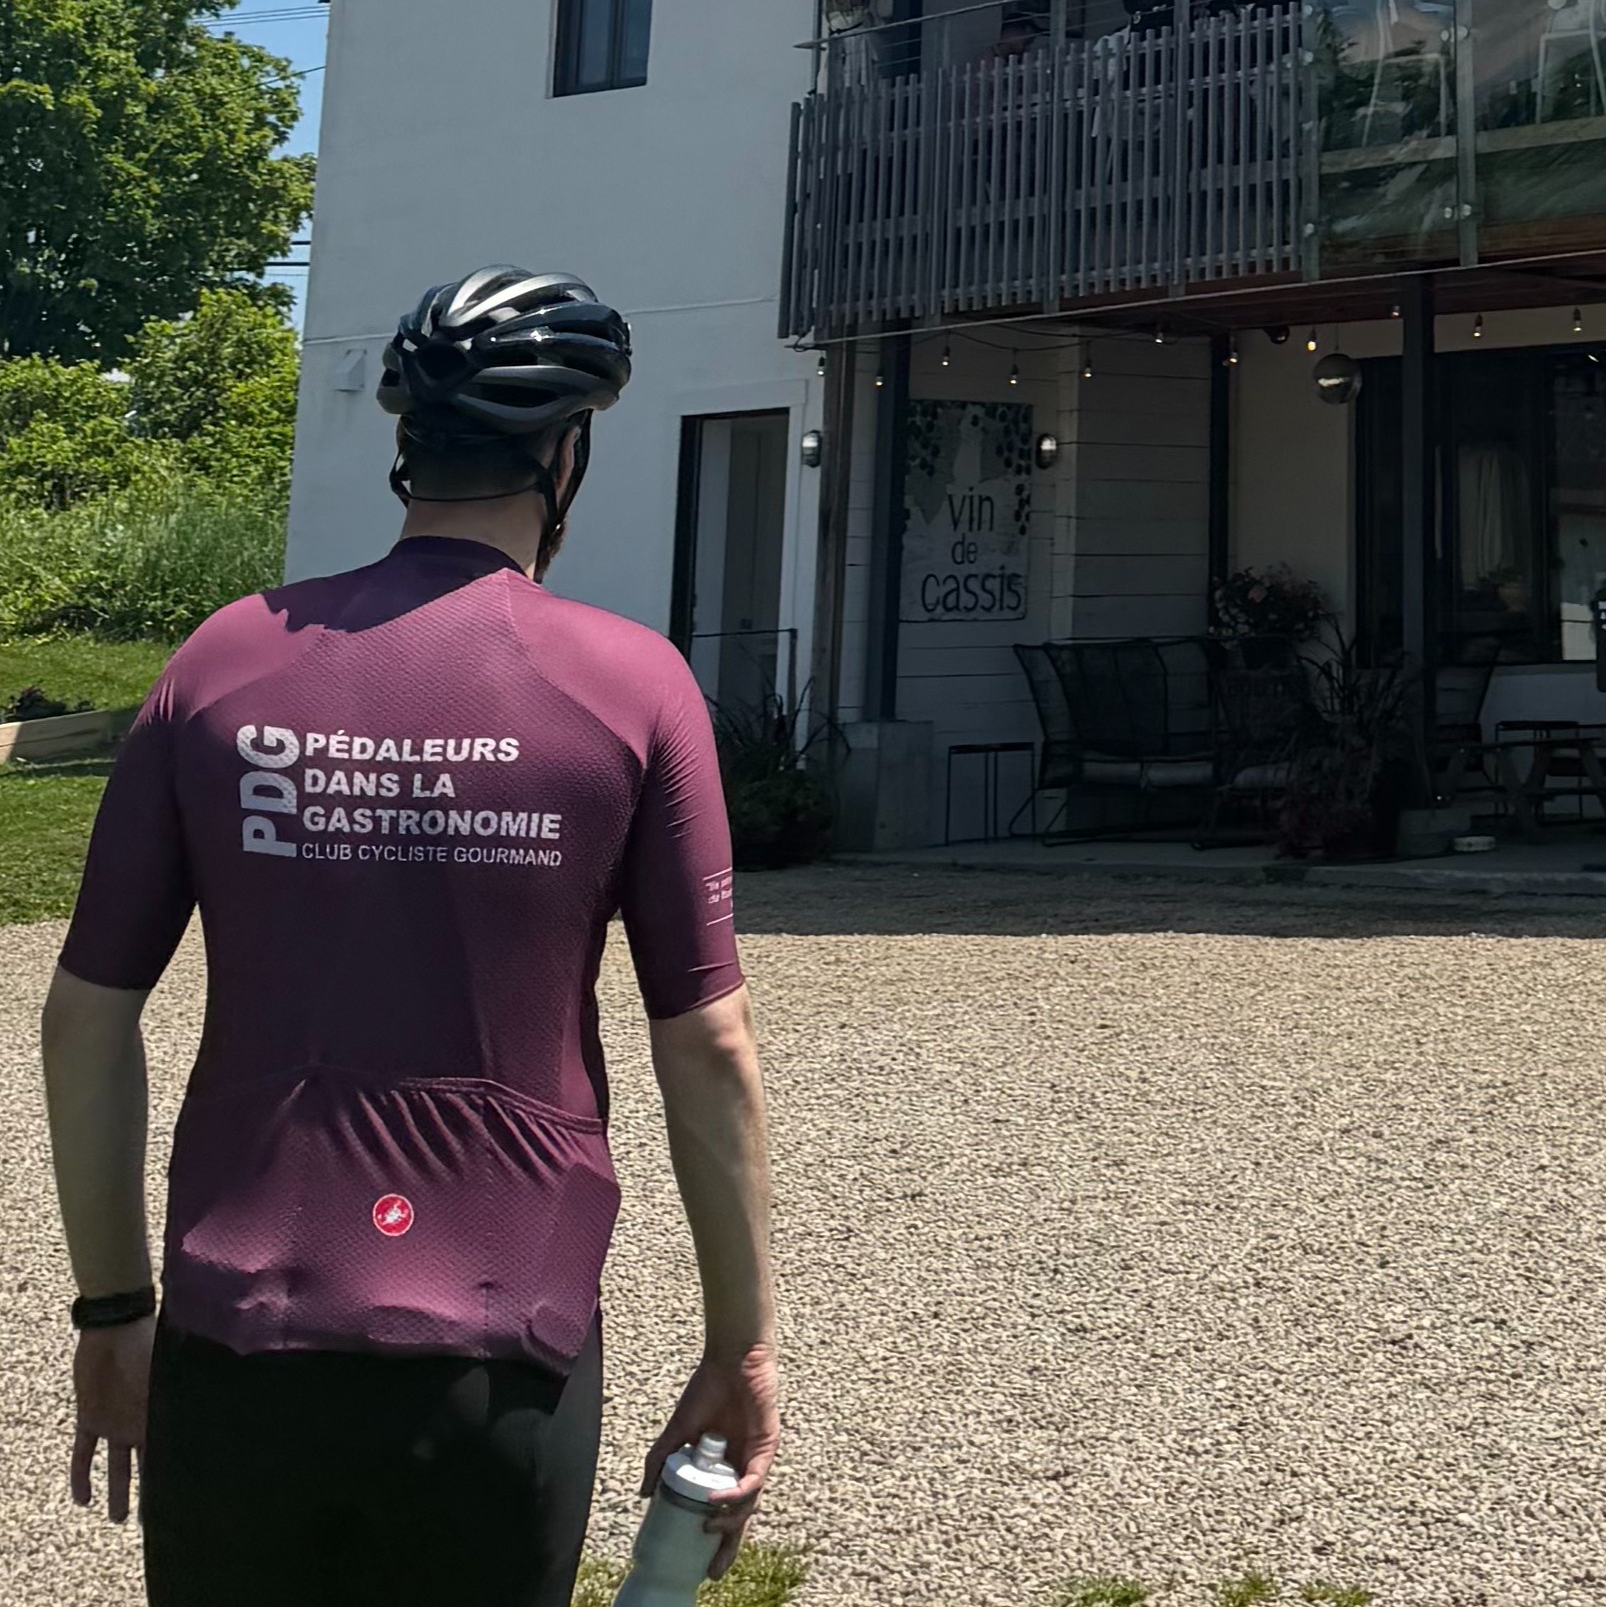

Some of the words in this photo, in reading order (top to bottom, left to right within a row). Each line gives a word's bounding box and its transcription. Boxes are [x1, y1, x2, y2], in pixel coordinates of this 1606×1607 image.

[948, 487, 994, 532] vin
[952, 534, 977, 565] de
[921, 565, 1022, 613] cassis
[305, 730, 520, 762] PÉDALEURS
[236, 725, 299, 857] PDG
[304, 768, 400, 798] DANS
[412, 773, 456, 798] LA
[303, 805, 562, 839] GASTRONOMIE
[302, 843, 351, 860] CLUB
[358, 845, 448, 862] CYCLISTE
[454, 847, 562, 867] GOURMAND
